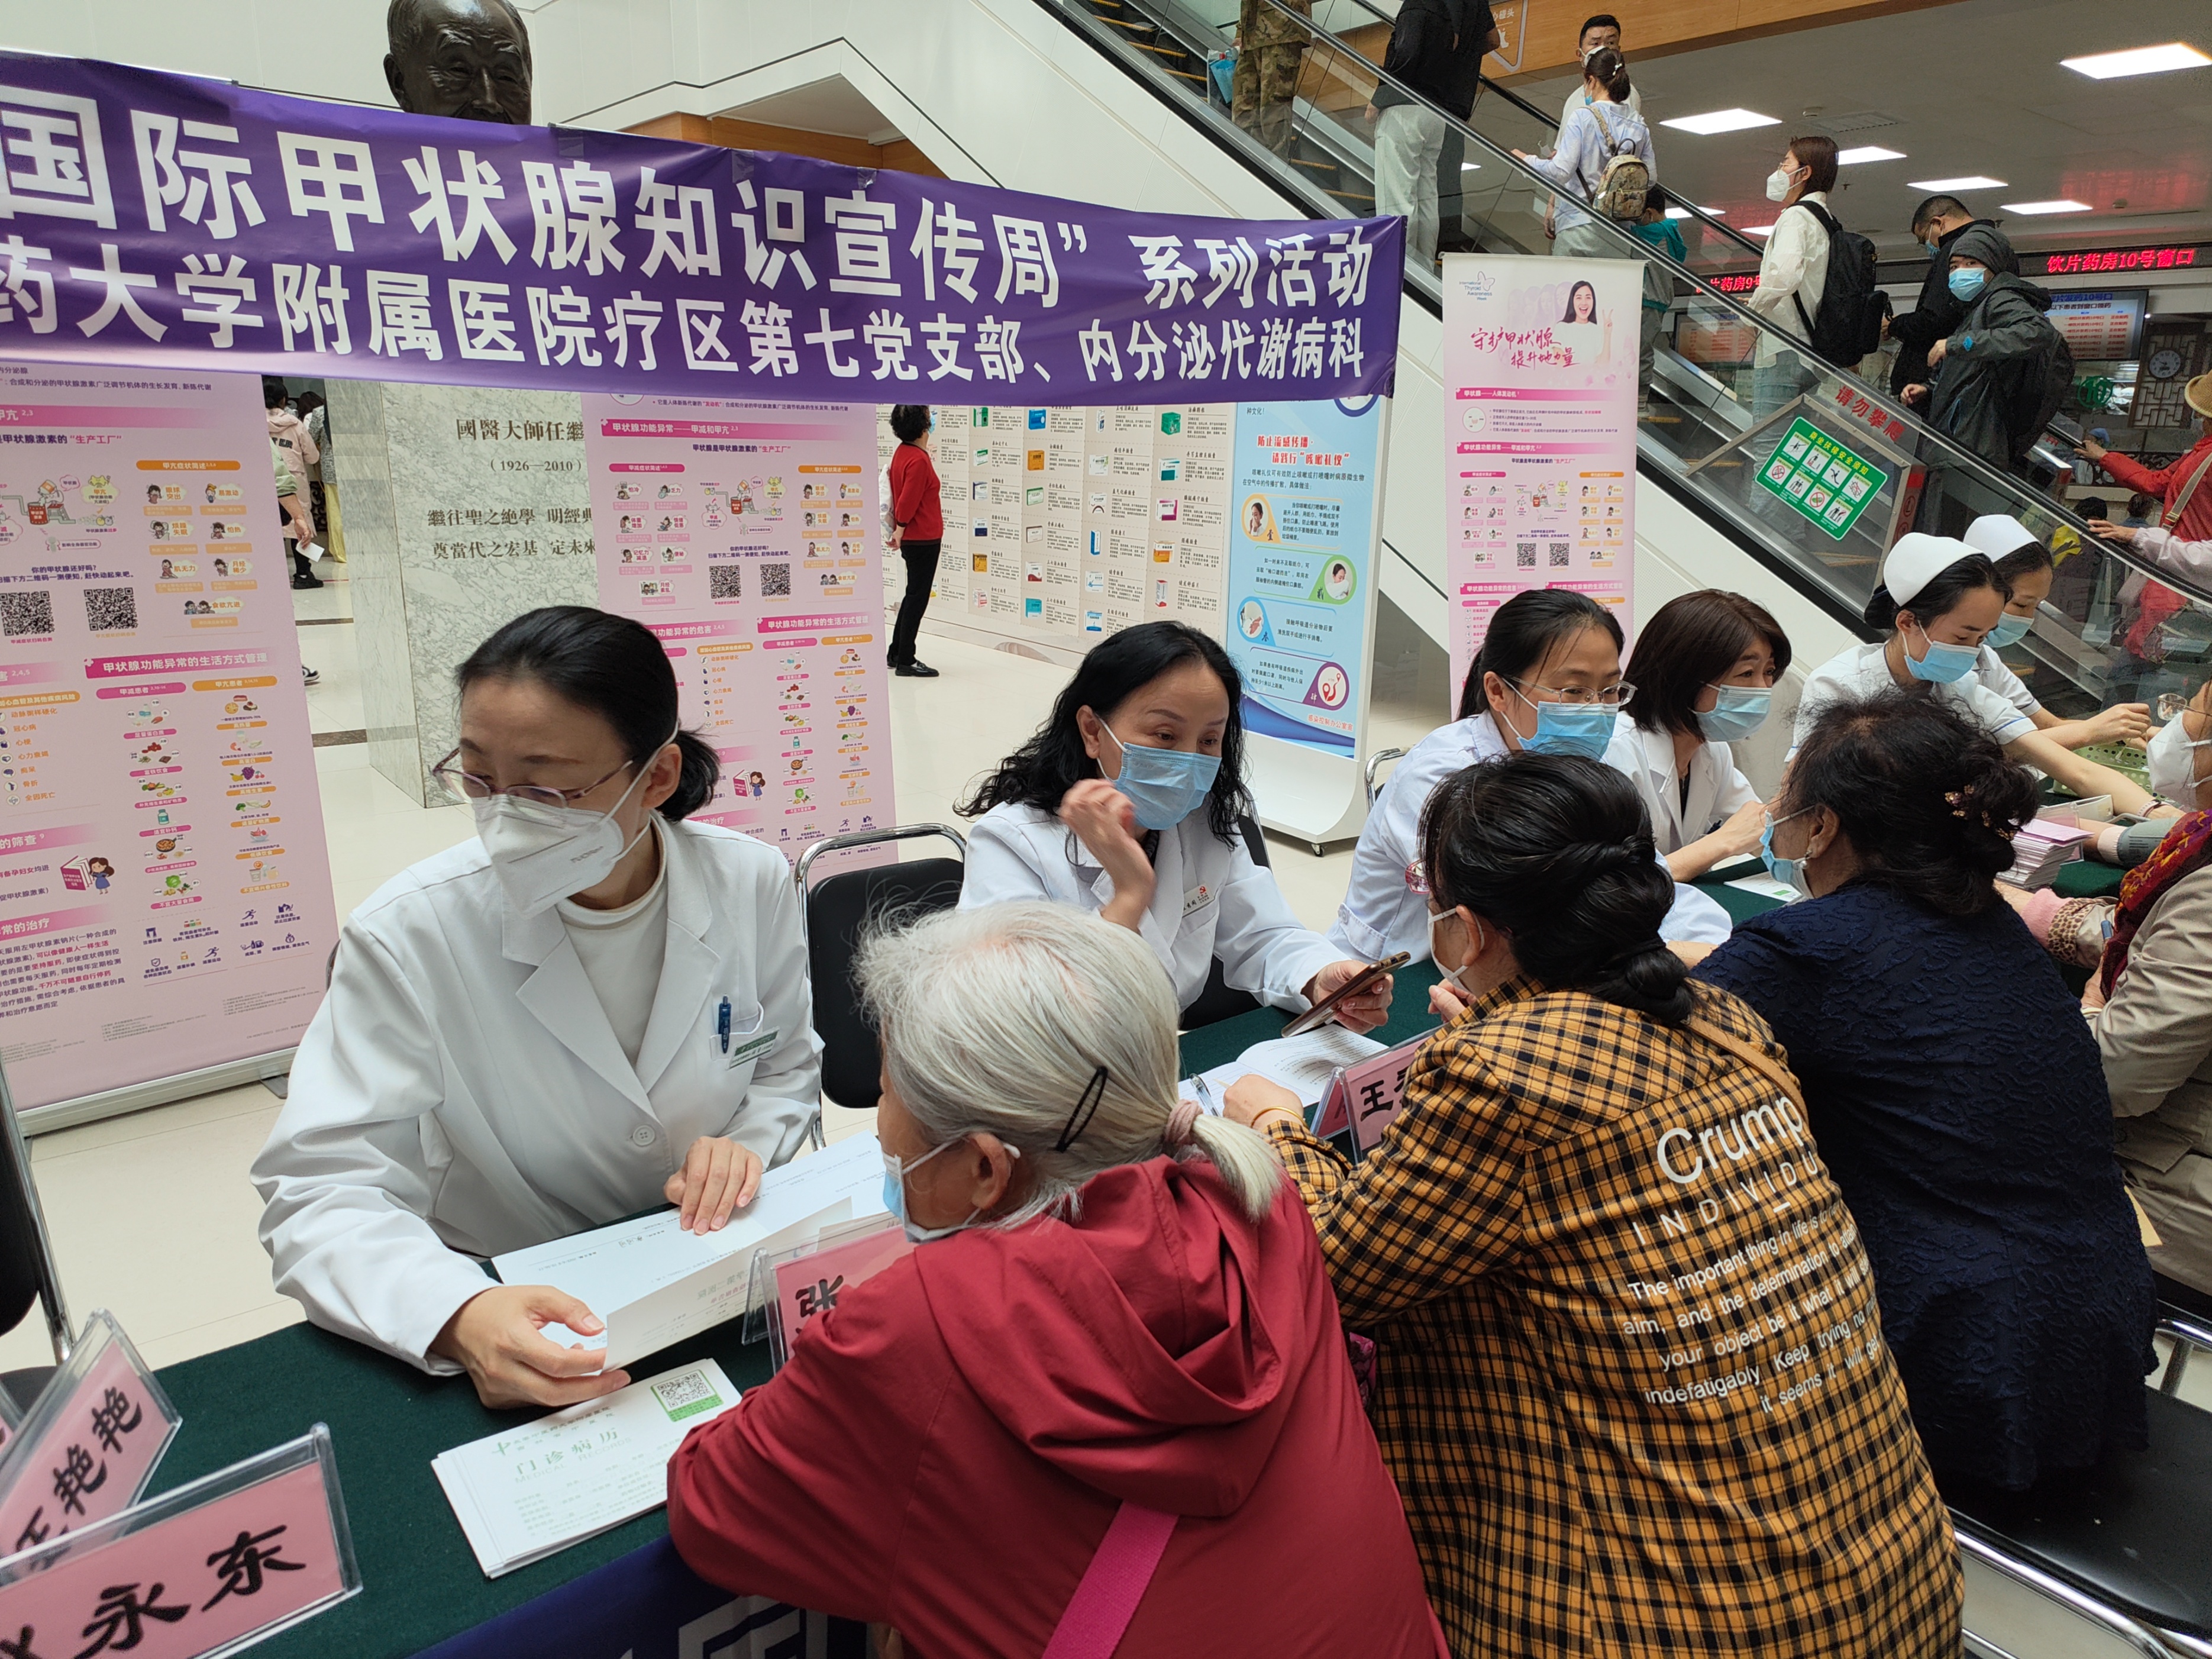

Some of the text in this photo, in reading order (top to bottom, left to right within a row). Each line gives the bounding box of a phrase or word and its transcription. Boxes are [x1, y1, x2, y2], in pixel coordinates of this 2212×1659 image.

[1128, 225, 1374, 311] 系列活动
[2047, 248, 2195, 273] 饮片药房10号窗口
[1471, 327, 1562, 353] 守护甲状腺
[1835, 385, 1905, 442] 请勿攀爬
[612, 422, 729, 435] 甲状腺功能异常——甲减和甲亢
[1272, 452, 1349, 466] 请践行“咳嗽礼仪”
[1809, 431, 1869, 475] 乘坐扶梯安全须知
[768, 615, 868, 630] 甲状腺功能异常的生活方式管理
[103, 653, 268, 673] 甲状腺功能异常的生活方式管理
[11, 708, 57, 718] 动脉粥样硬化
[1308, 714, 1353, 731] 感染控制办公室宣
[14, 724, 36, 732] 冠心病
[18, 751, 49, 760] 心力衰竭
[25, 792, 55, 802] 全因死亡
[0, 835, 37, 850] 的筛查
[159, 898, 194, 908] 不宜大量食用
[0, 918, 50, 936] 常的治疗
[0, 958, 122, 987] 也需要每天服药，同时每年定期检测
[1627, 1280, 1669, 1301] The
[1671, 1251, 1747, 1293] important
[1745, 1234, 1778, 1266] thing
[1779, 1229, 1792, 1246] in
[1792, 1221, 1808, 1239] life
[1810, 1215, 1819, 1229] is
[795, 1274, 844, 1318] 张
[1623, 1317, 1666, 1335] aim,
[1677, 1304, 1712, 1328] and
[1719, 1293, 1744, 1315] the
[1750, 1248, 1829, 1302] determination
[1829, 1242, 1840, 1257] to
[1659, 1266, 1861, 1373] your object be it what it will
[1644, 1366, 1761, 1405] indefatigably
[1772, 1344, 1810, 1372] Keep
[1818, 1321, 1852, 1349] trying
[1853, 1313, 1865, 1329] no
[1761, 1334, 1880, 1414] it seems it will get
[515, 1437, 632, 1484] MEDICAL RECORDS
[516, 1427, 618, 1475] 门诊病历
